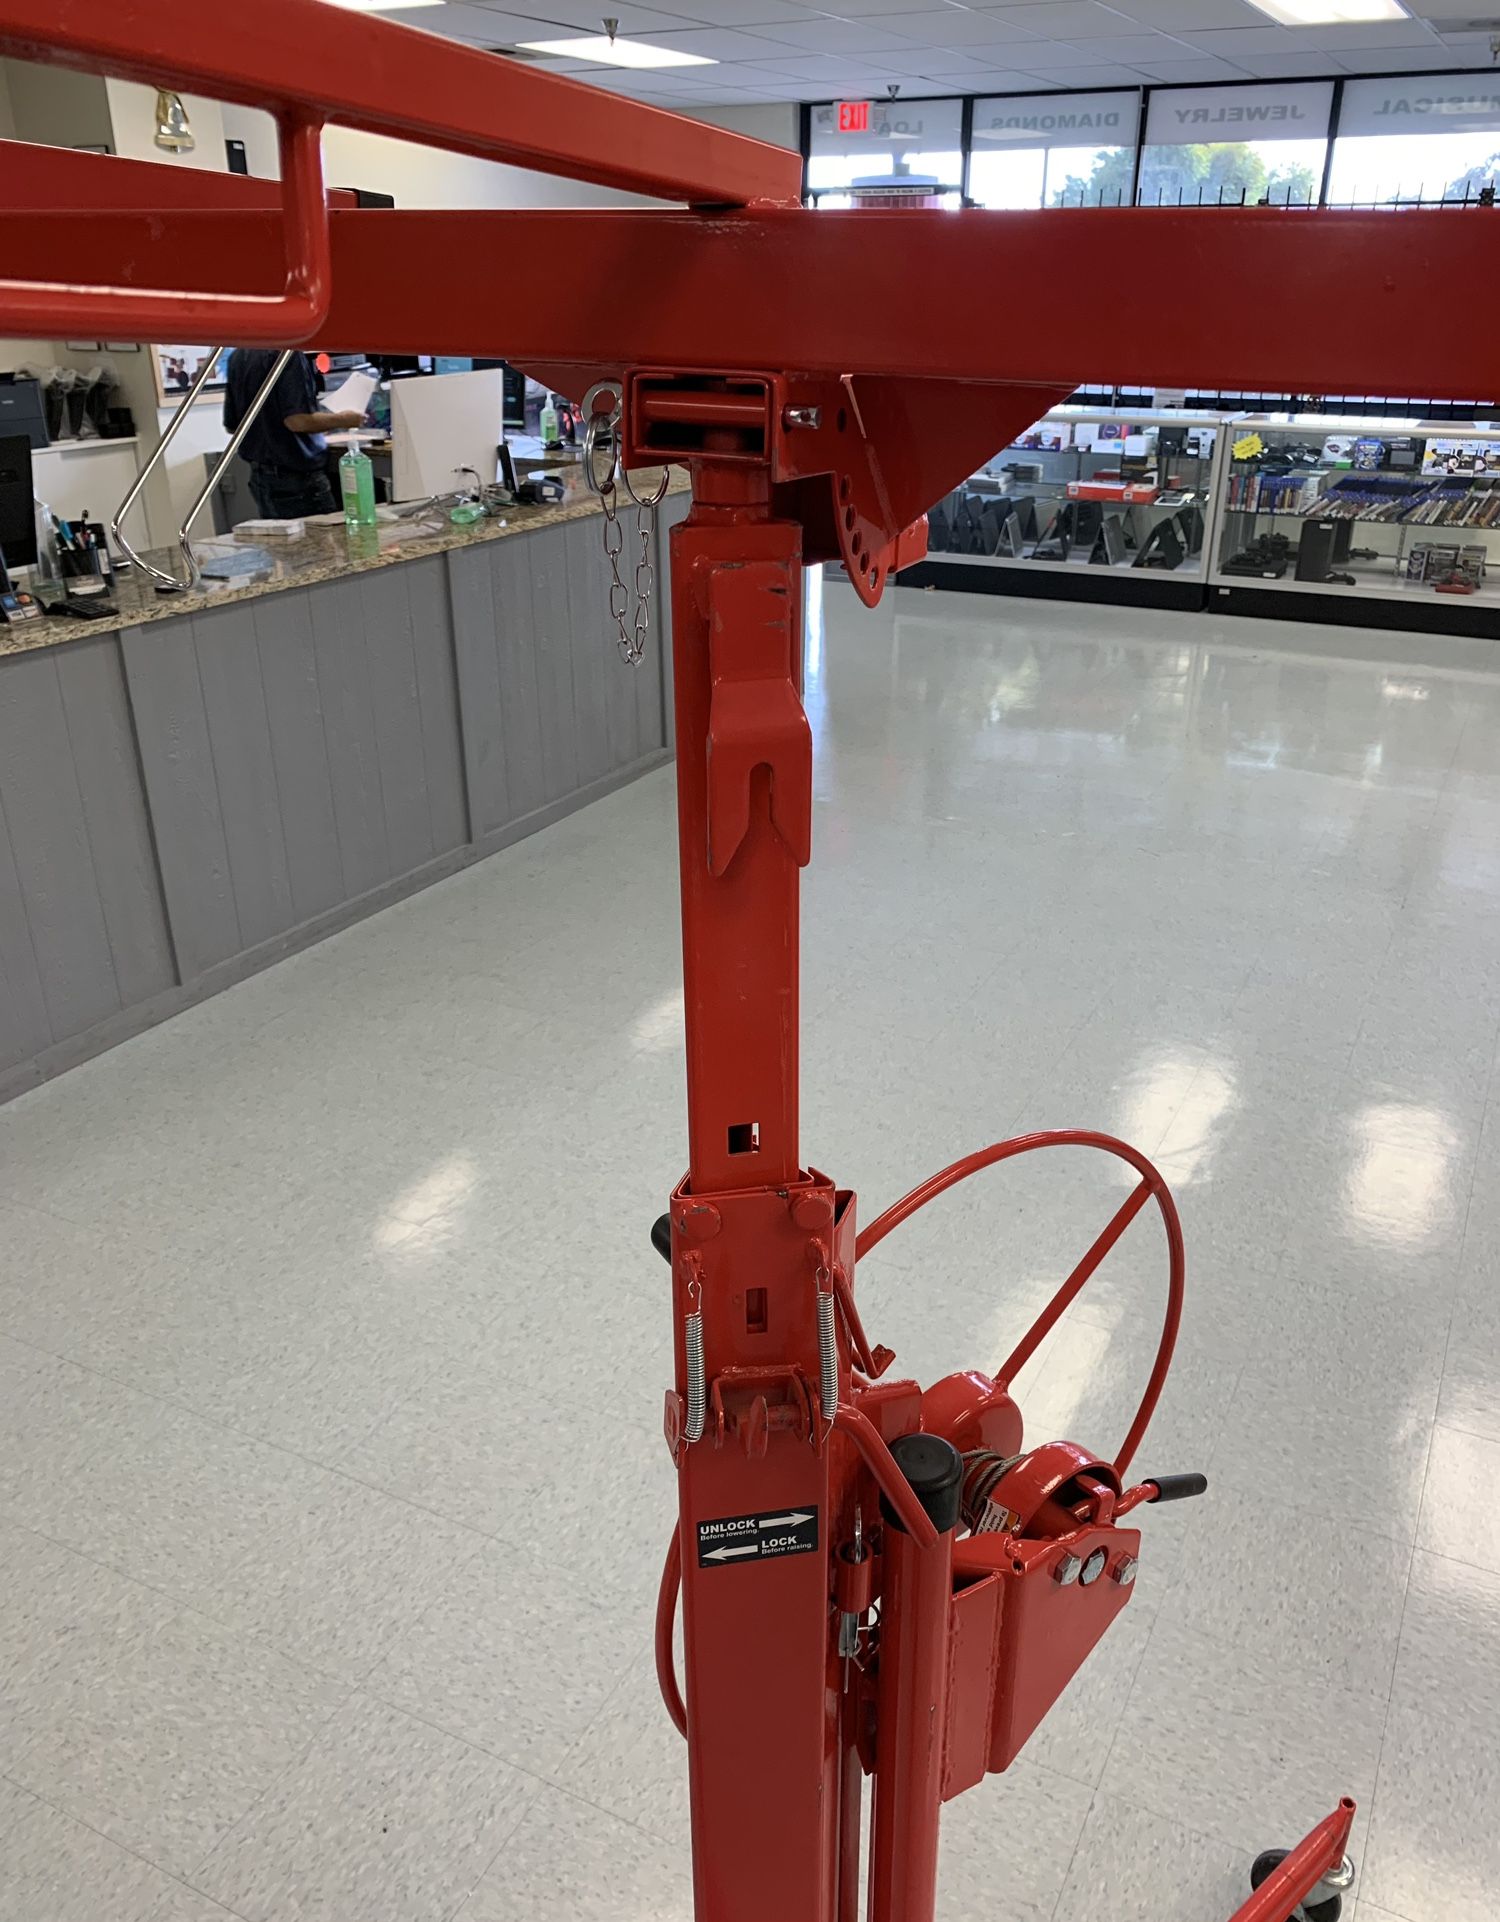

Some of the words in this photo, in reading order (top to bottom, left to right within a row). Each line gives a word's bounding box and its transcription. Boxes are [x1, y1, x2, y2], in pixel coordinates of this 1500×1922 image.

[839, 102, 869, 131] EXIT
[700, 1519, 756, 1535] UNLOCK
[700, 1532, 725, 1541] Before
[761, 1536, 797, 1549] LOCK
[761, 1546, 786, 1555] Before
